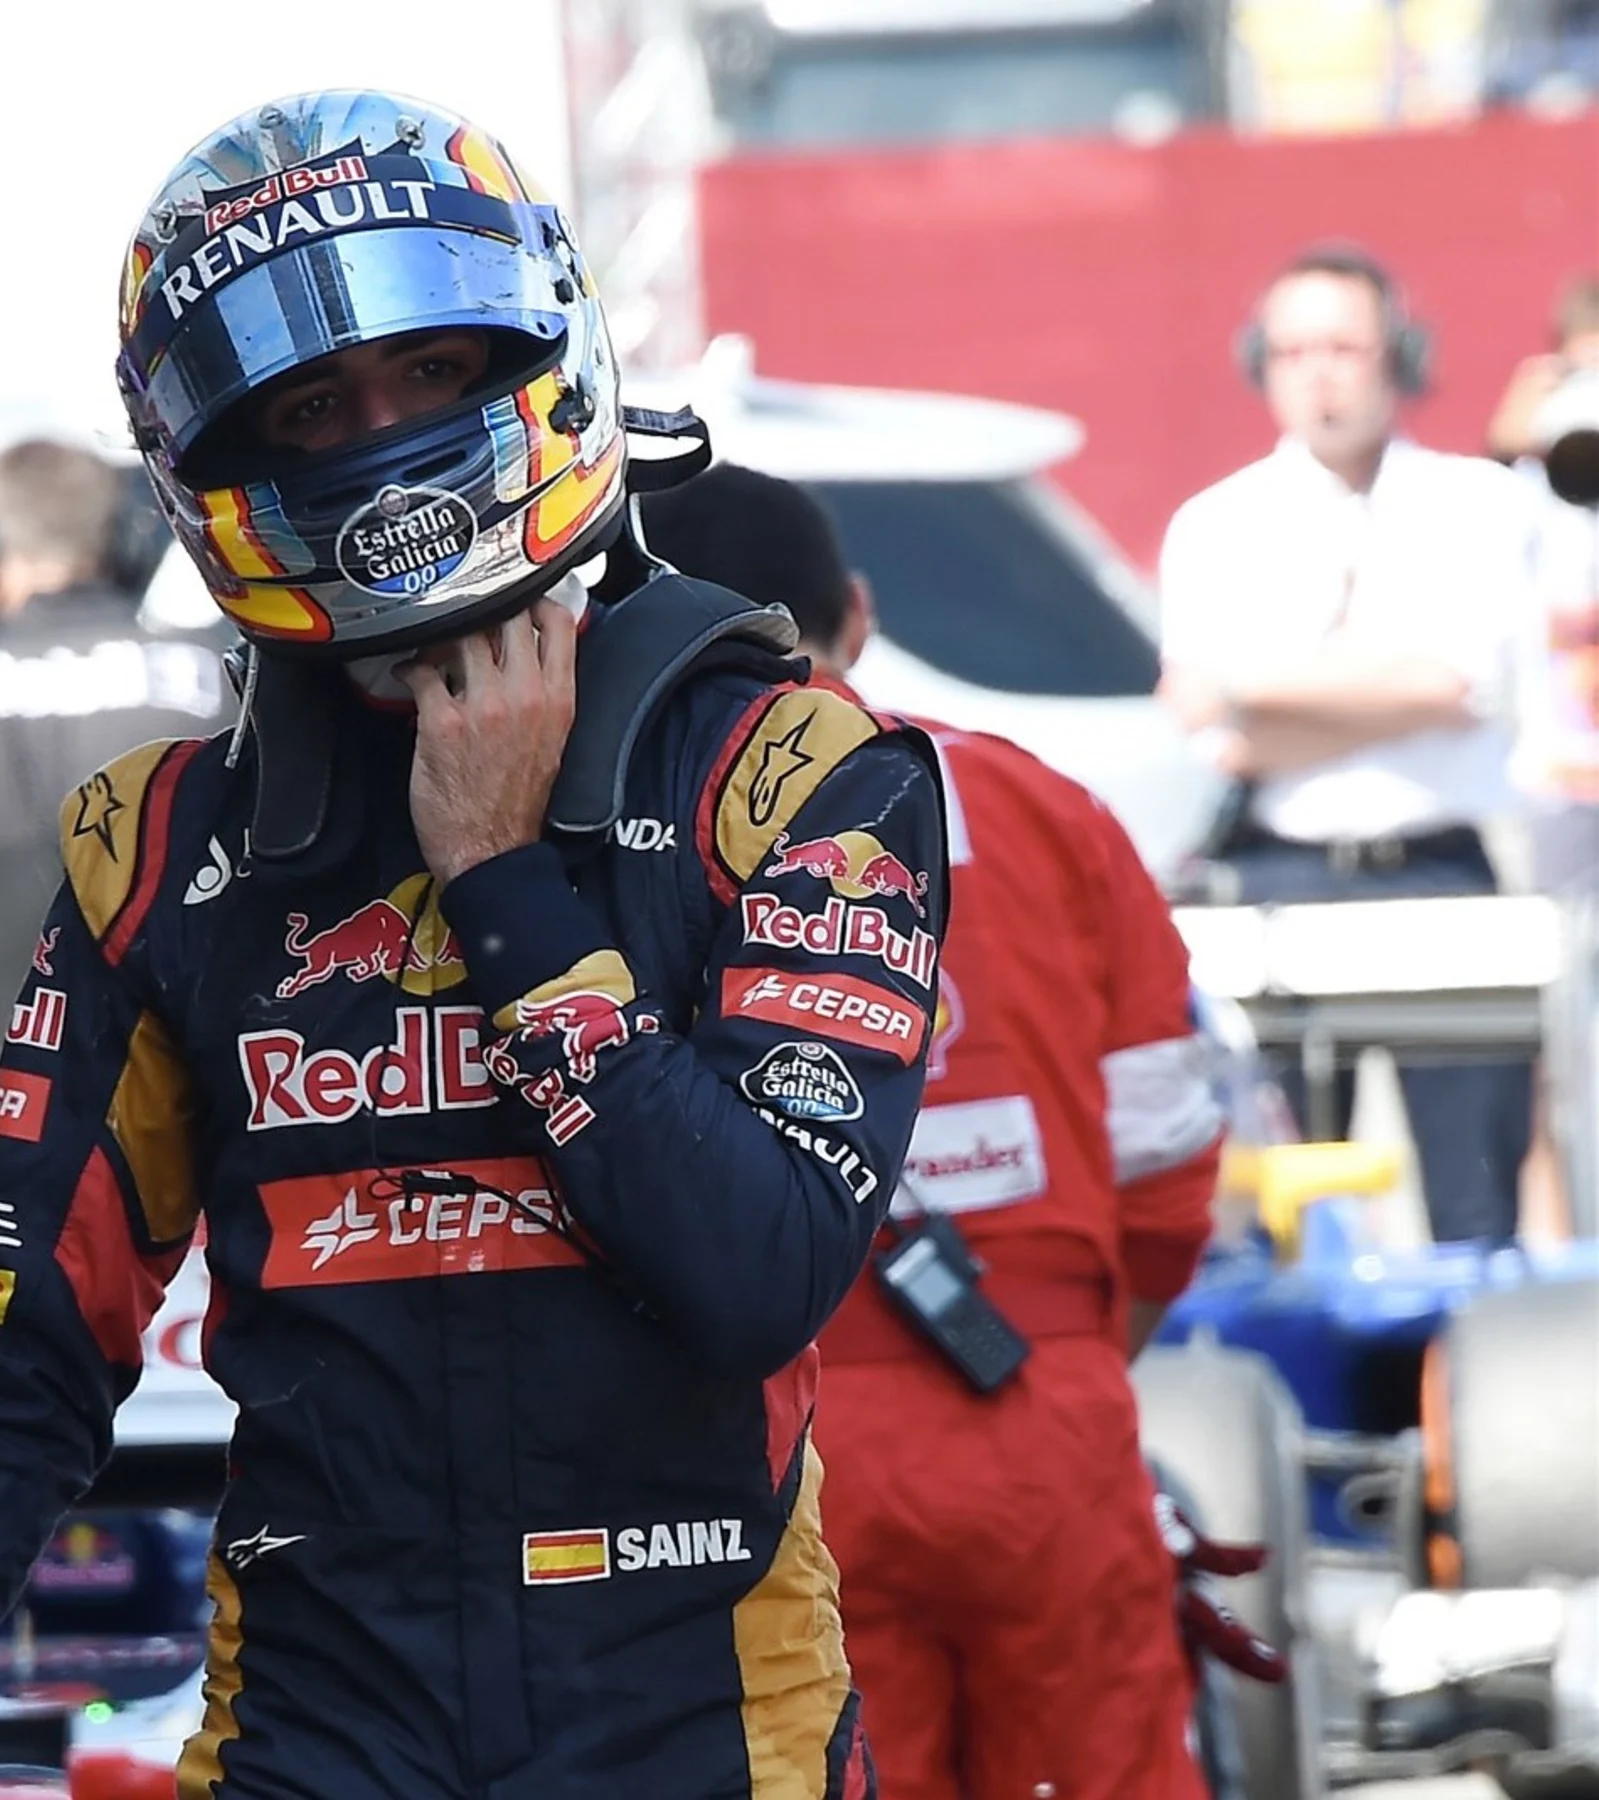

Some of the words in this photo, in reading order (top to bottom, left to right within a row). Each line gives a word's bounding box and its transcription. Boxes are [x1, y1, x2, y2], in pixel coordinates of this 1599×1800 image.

[204, 177, 282, 236] Red
[282, 155, 369, 198] Bull
[161, 181, 436, 320] RENAULT
[353, 506, 456, 557] Estrella
[367, 534, 460, 580] Galicia
[741, 893, 845, 956] Red
[843, 905, 937, 991] Bull
[788, 983, 913, 1041] CEPSA
[237, 1005, 431, 1132] Red
[762, 1055, 849, 1097] Estrella
[762, 1076, 844, 1110] Galicia
[616, 1518, 752, 1573] SAINZ
